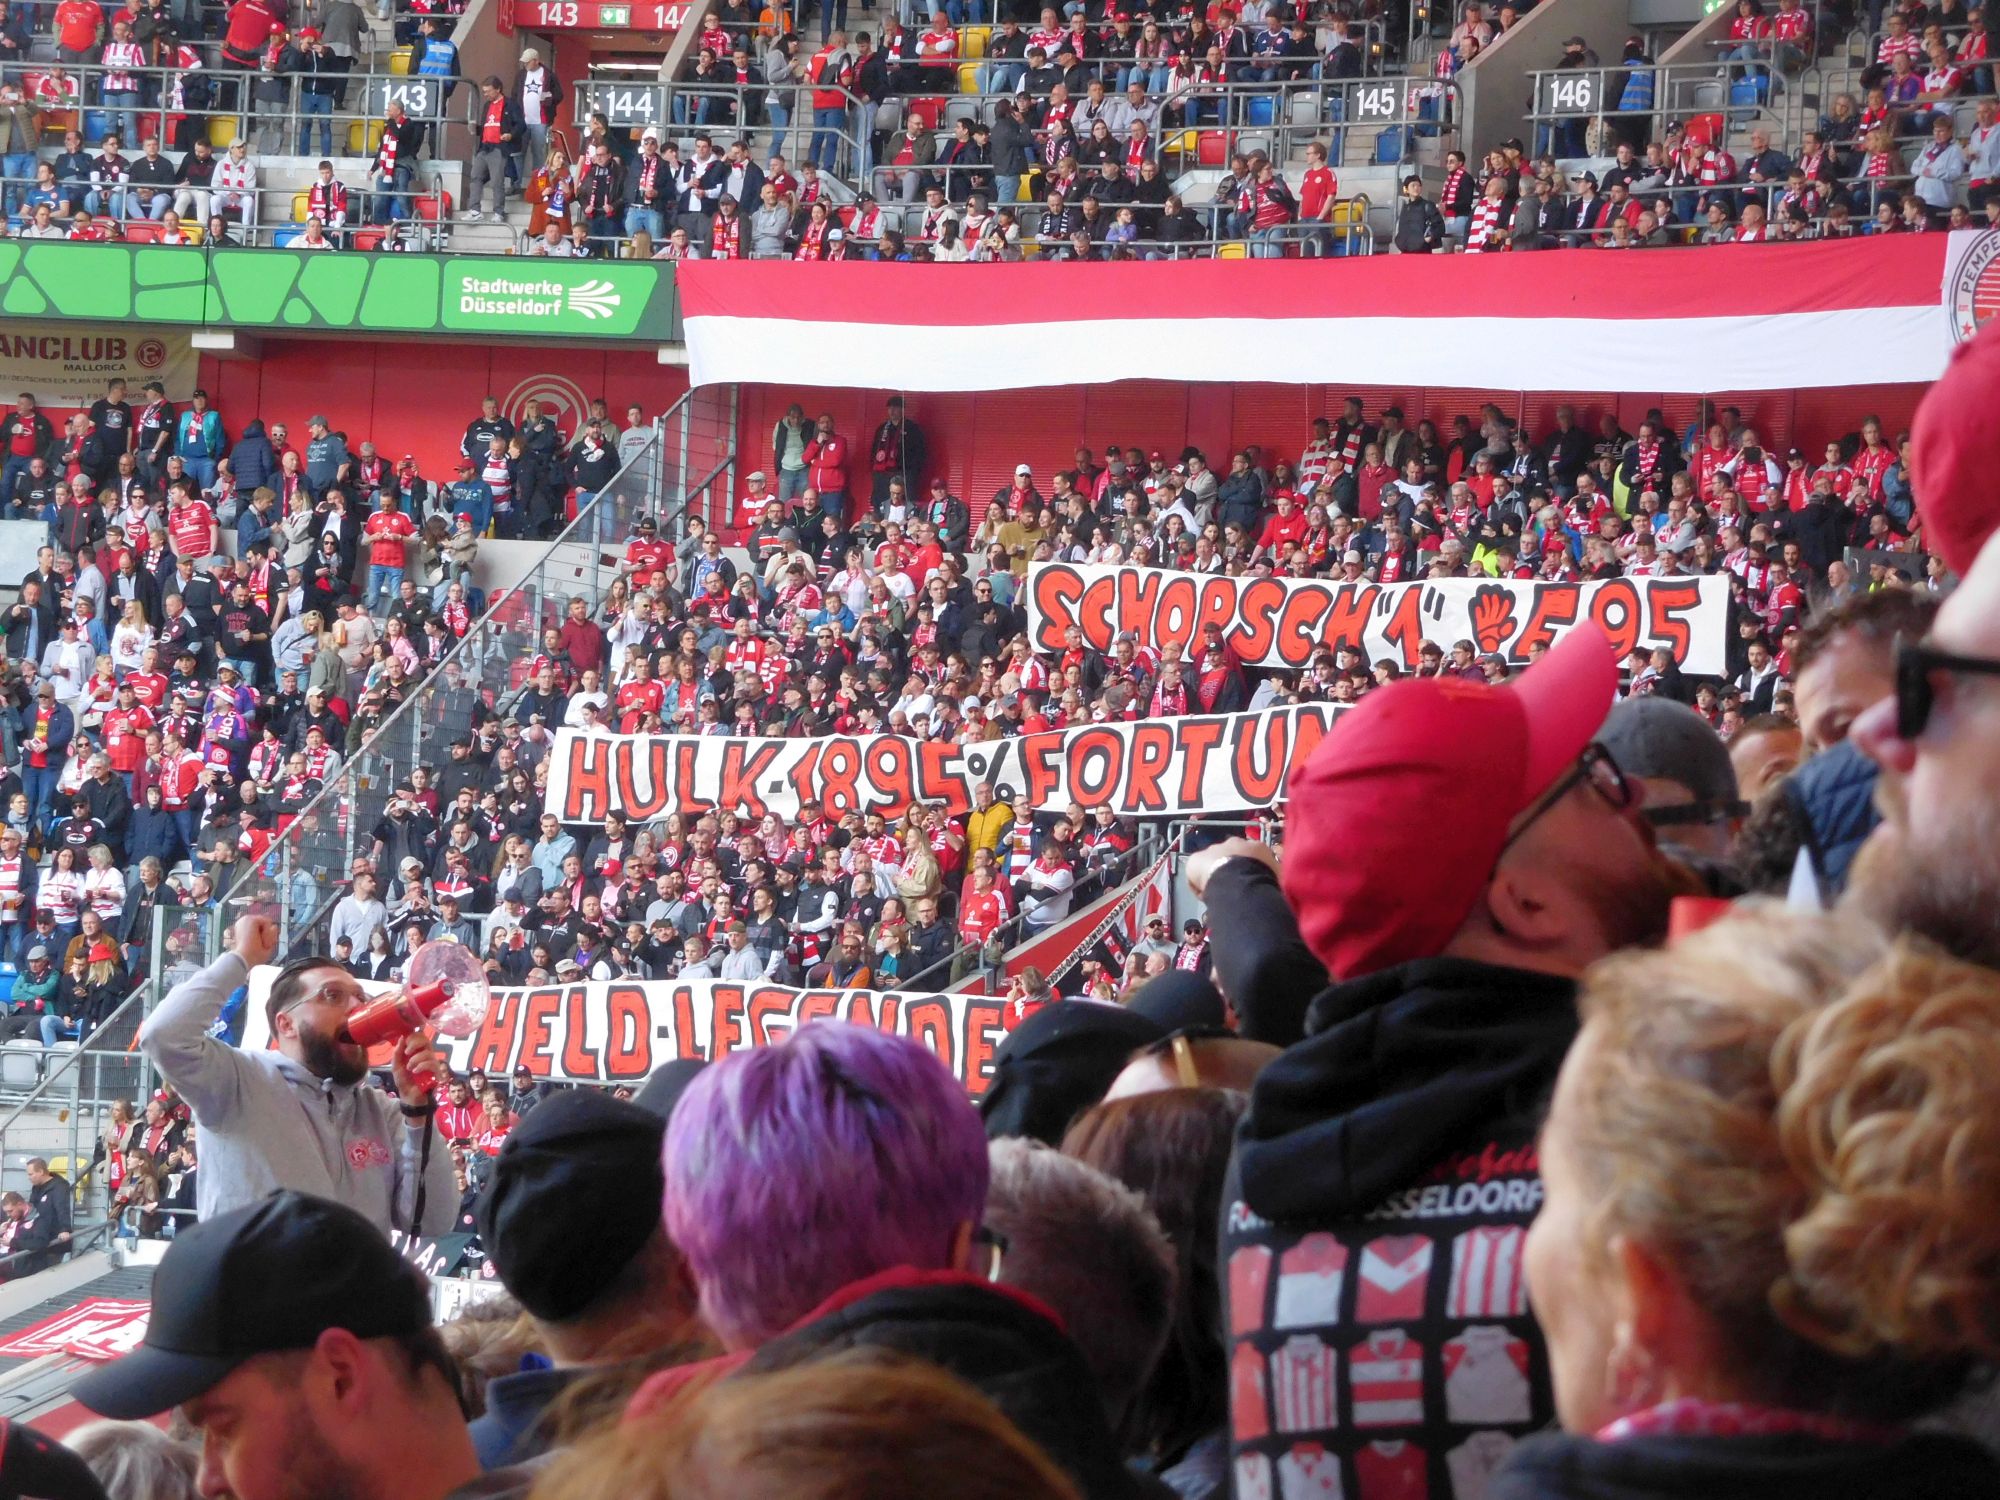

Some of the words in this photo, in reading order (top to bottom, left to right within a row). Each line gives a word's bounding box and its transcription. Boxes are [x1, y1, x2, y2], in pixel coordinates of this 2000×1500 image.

[537, 2, 578, 27] 143
[381, 84, 428, 112] 143
[606, 91, 654, 118] 144
[1356, 87, 1396, 116] 145
[1550, 79, 1591, 108] 146
[462, 276, 563, 296] Stadtwerke
[460, 295, 562, 316] Düsseldorf
[63, 362, 127, 372] MALLORCA
[1019, 705, 1348, 812] FORTUN
